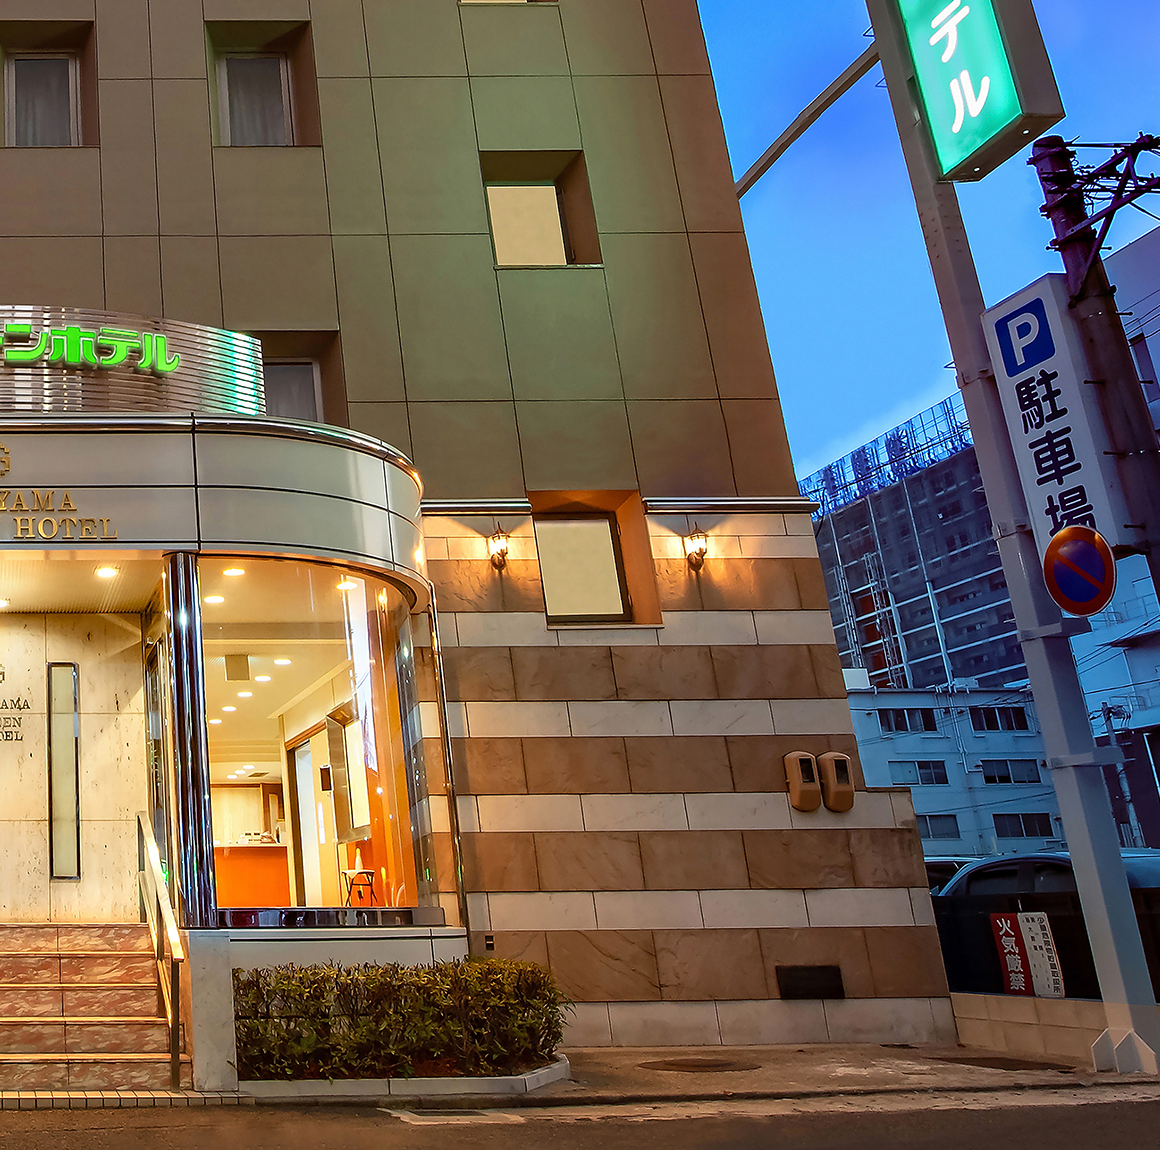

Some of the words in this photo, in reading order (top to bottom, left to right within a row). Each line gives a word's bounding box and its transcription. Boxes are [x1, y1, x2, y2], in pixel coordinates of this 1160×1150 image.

[1007, 312, 1040, 366] P
[13, 517, 119, 540] HOTEL
[996, 917, 1026, 991] 火気厳禁
